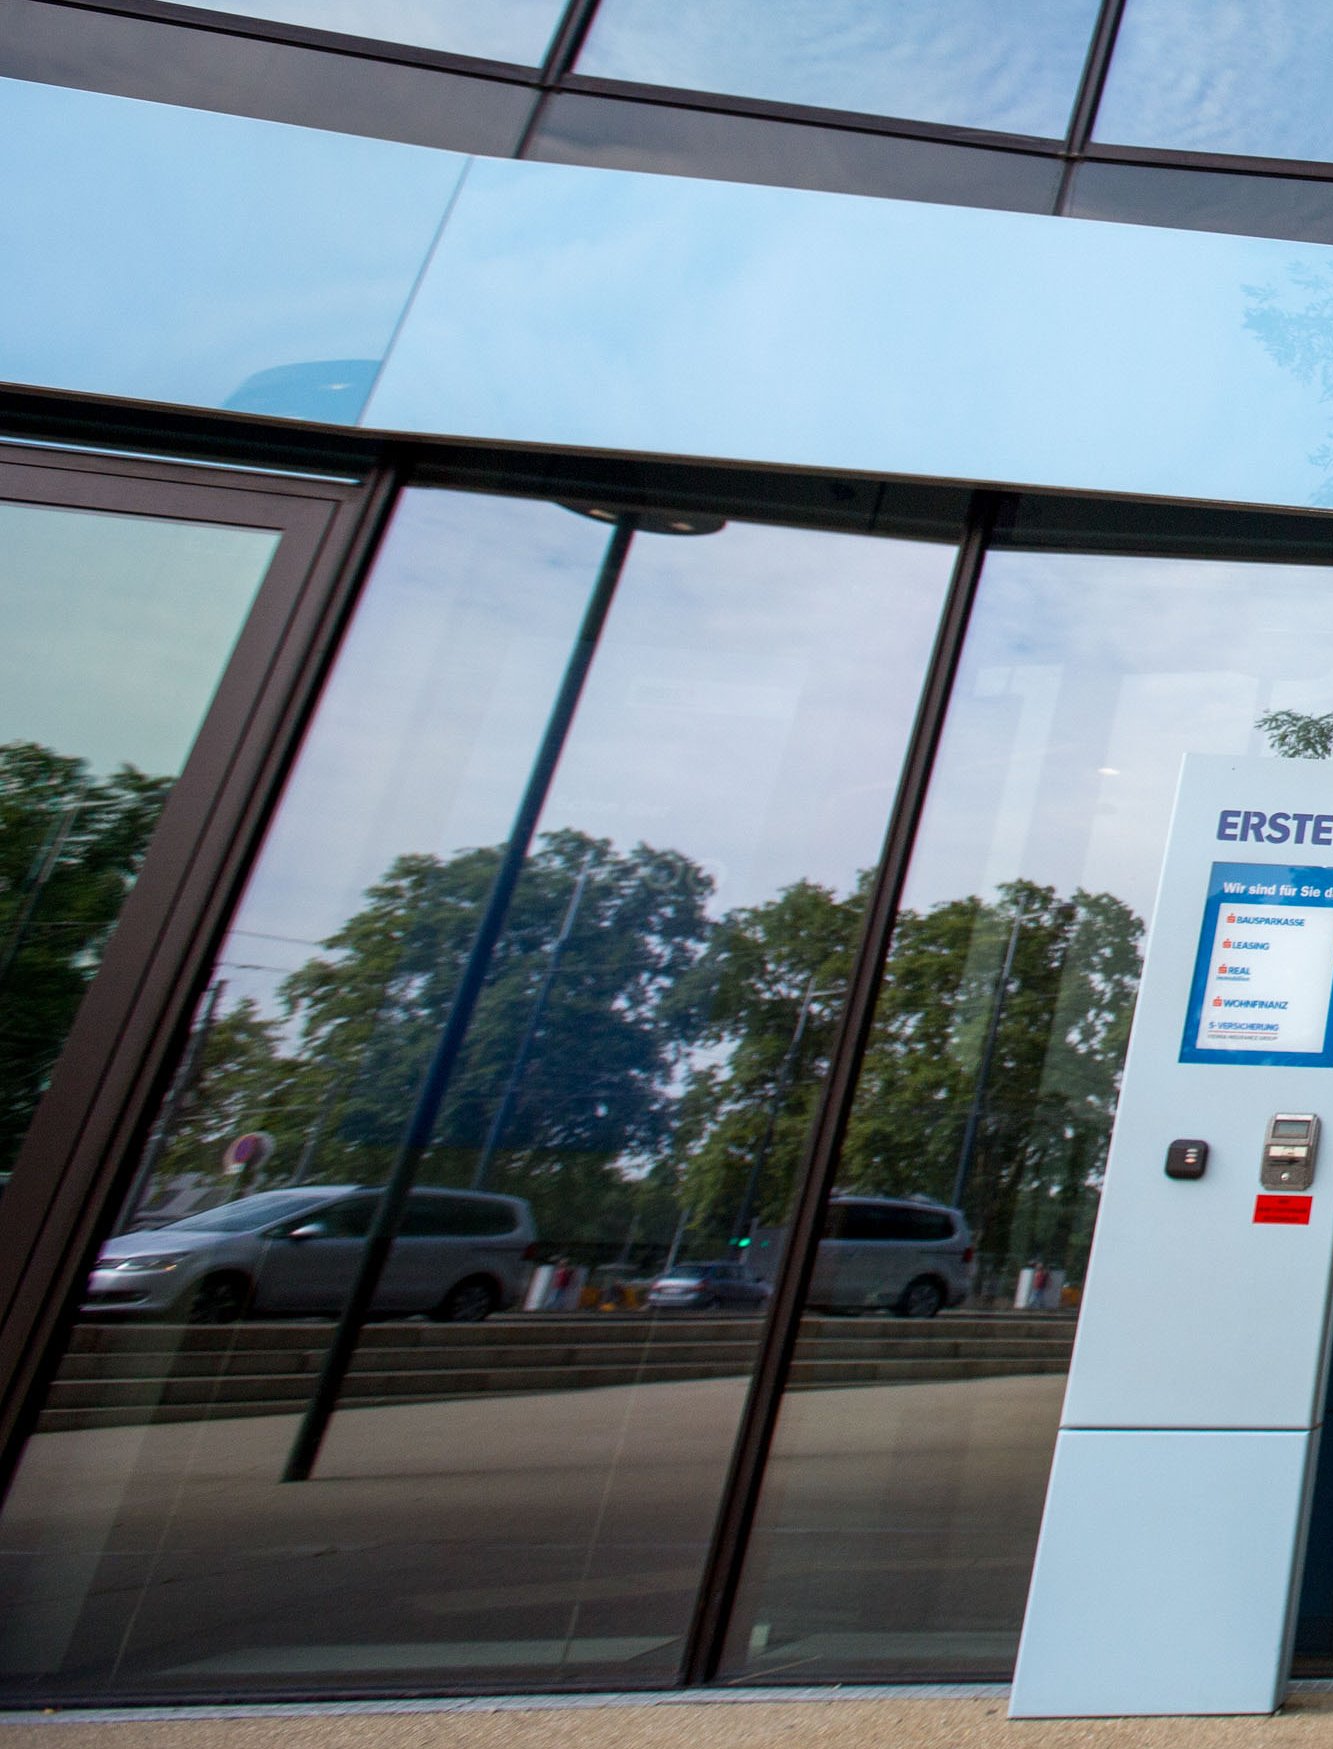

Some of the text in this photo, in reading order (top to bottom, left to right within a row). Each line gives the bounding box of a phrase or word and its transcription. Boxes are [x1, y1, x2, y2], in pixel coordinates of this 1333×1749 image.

[1223, 881, 1246, 894] Wir
[1248, 883, 1276, 895] sind
[1279, 884, 1298, 896] für
[1300, 885, 1321, 897] Sie
[1237, 916, 1306, 927] BAUSPARKASSE
[1232, 941, 1270, 951] LEASING
[1228, 966, 1250, 975] REAL
[1223, 999, 1289, 1010] WOHNFINANZ
